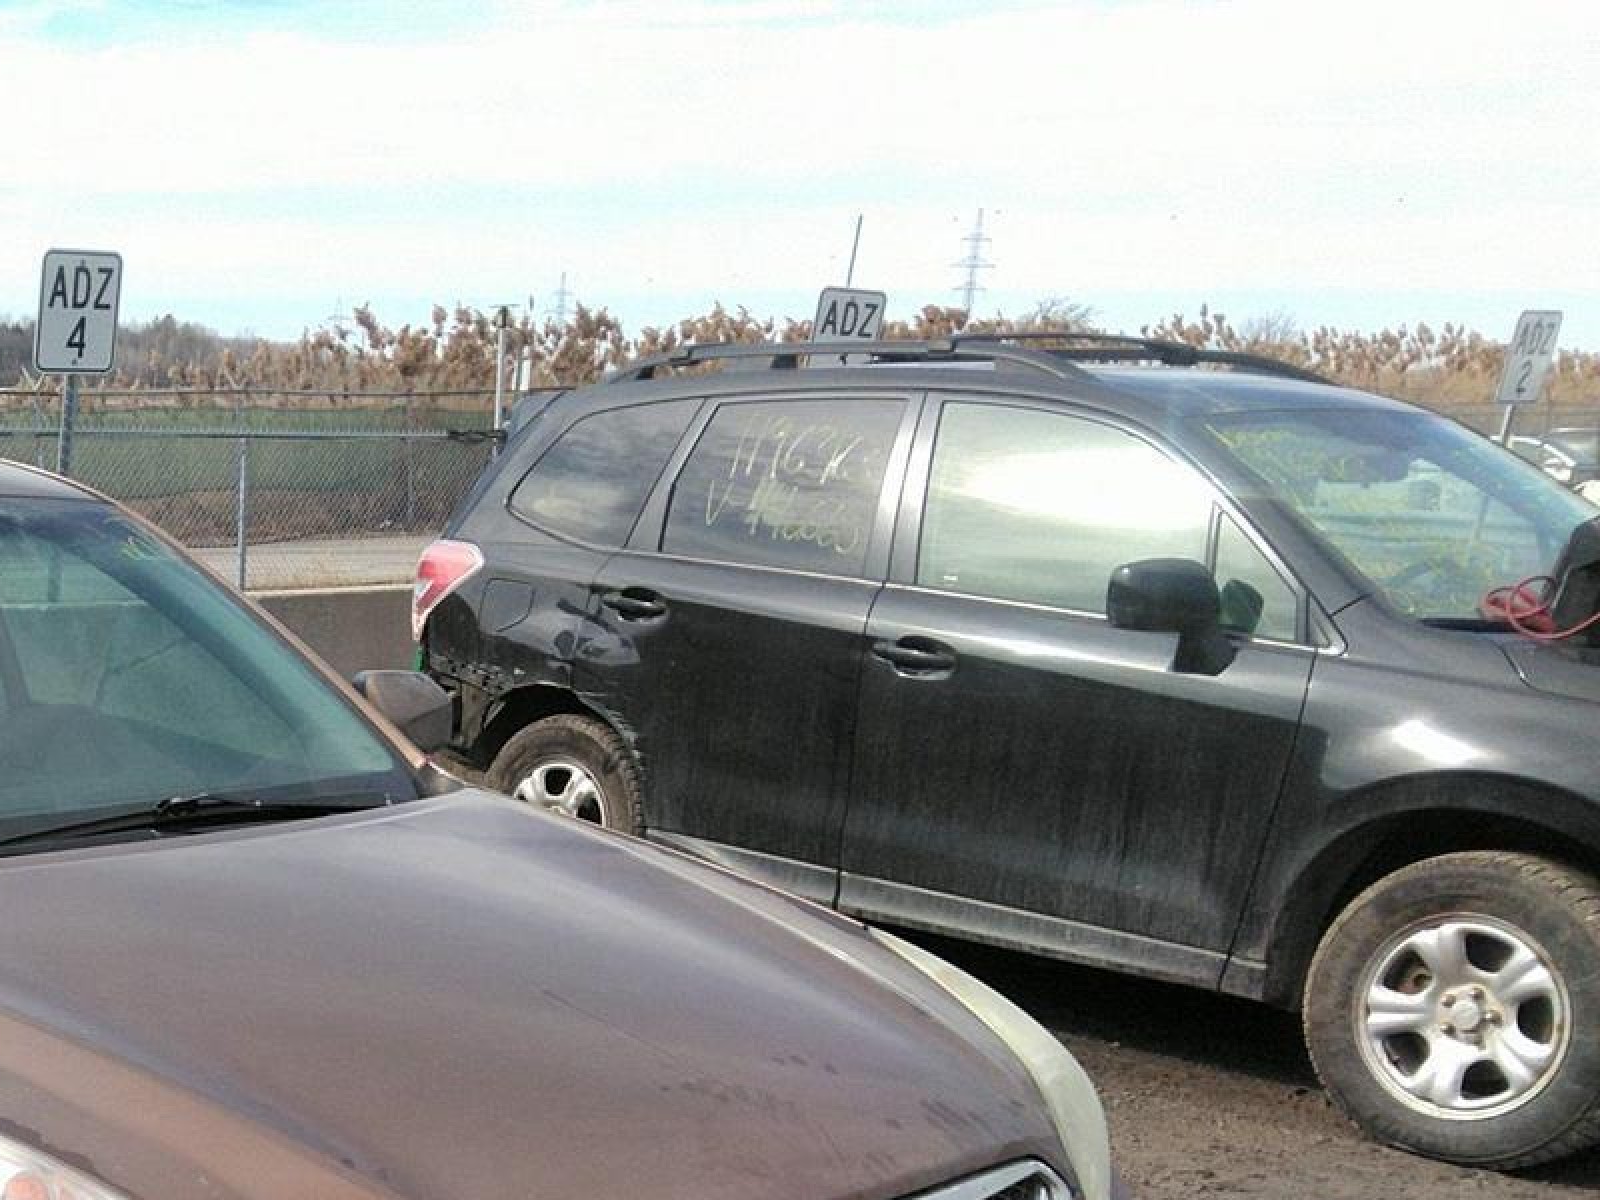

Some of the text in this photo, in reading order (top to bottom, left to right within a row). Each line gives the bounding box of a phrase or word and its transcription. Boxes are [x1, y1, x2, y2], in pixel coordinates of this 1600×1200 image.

[48, 265, 115, 310] ADZ
[66, 316, 87, 358] 4
[821, 299, 878, 338] ADZ
